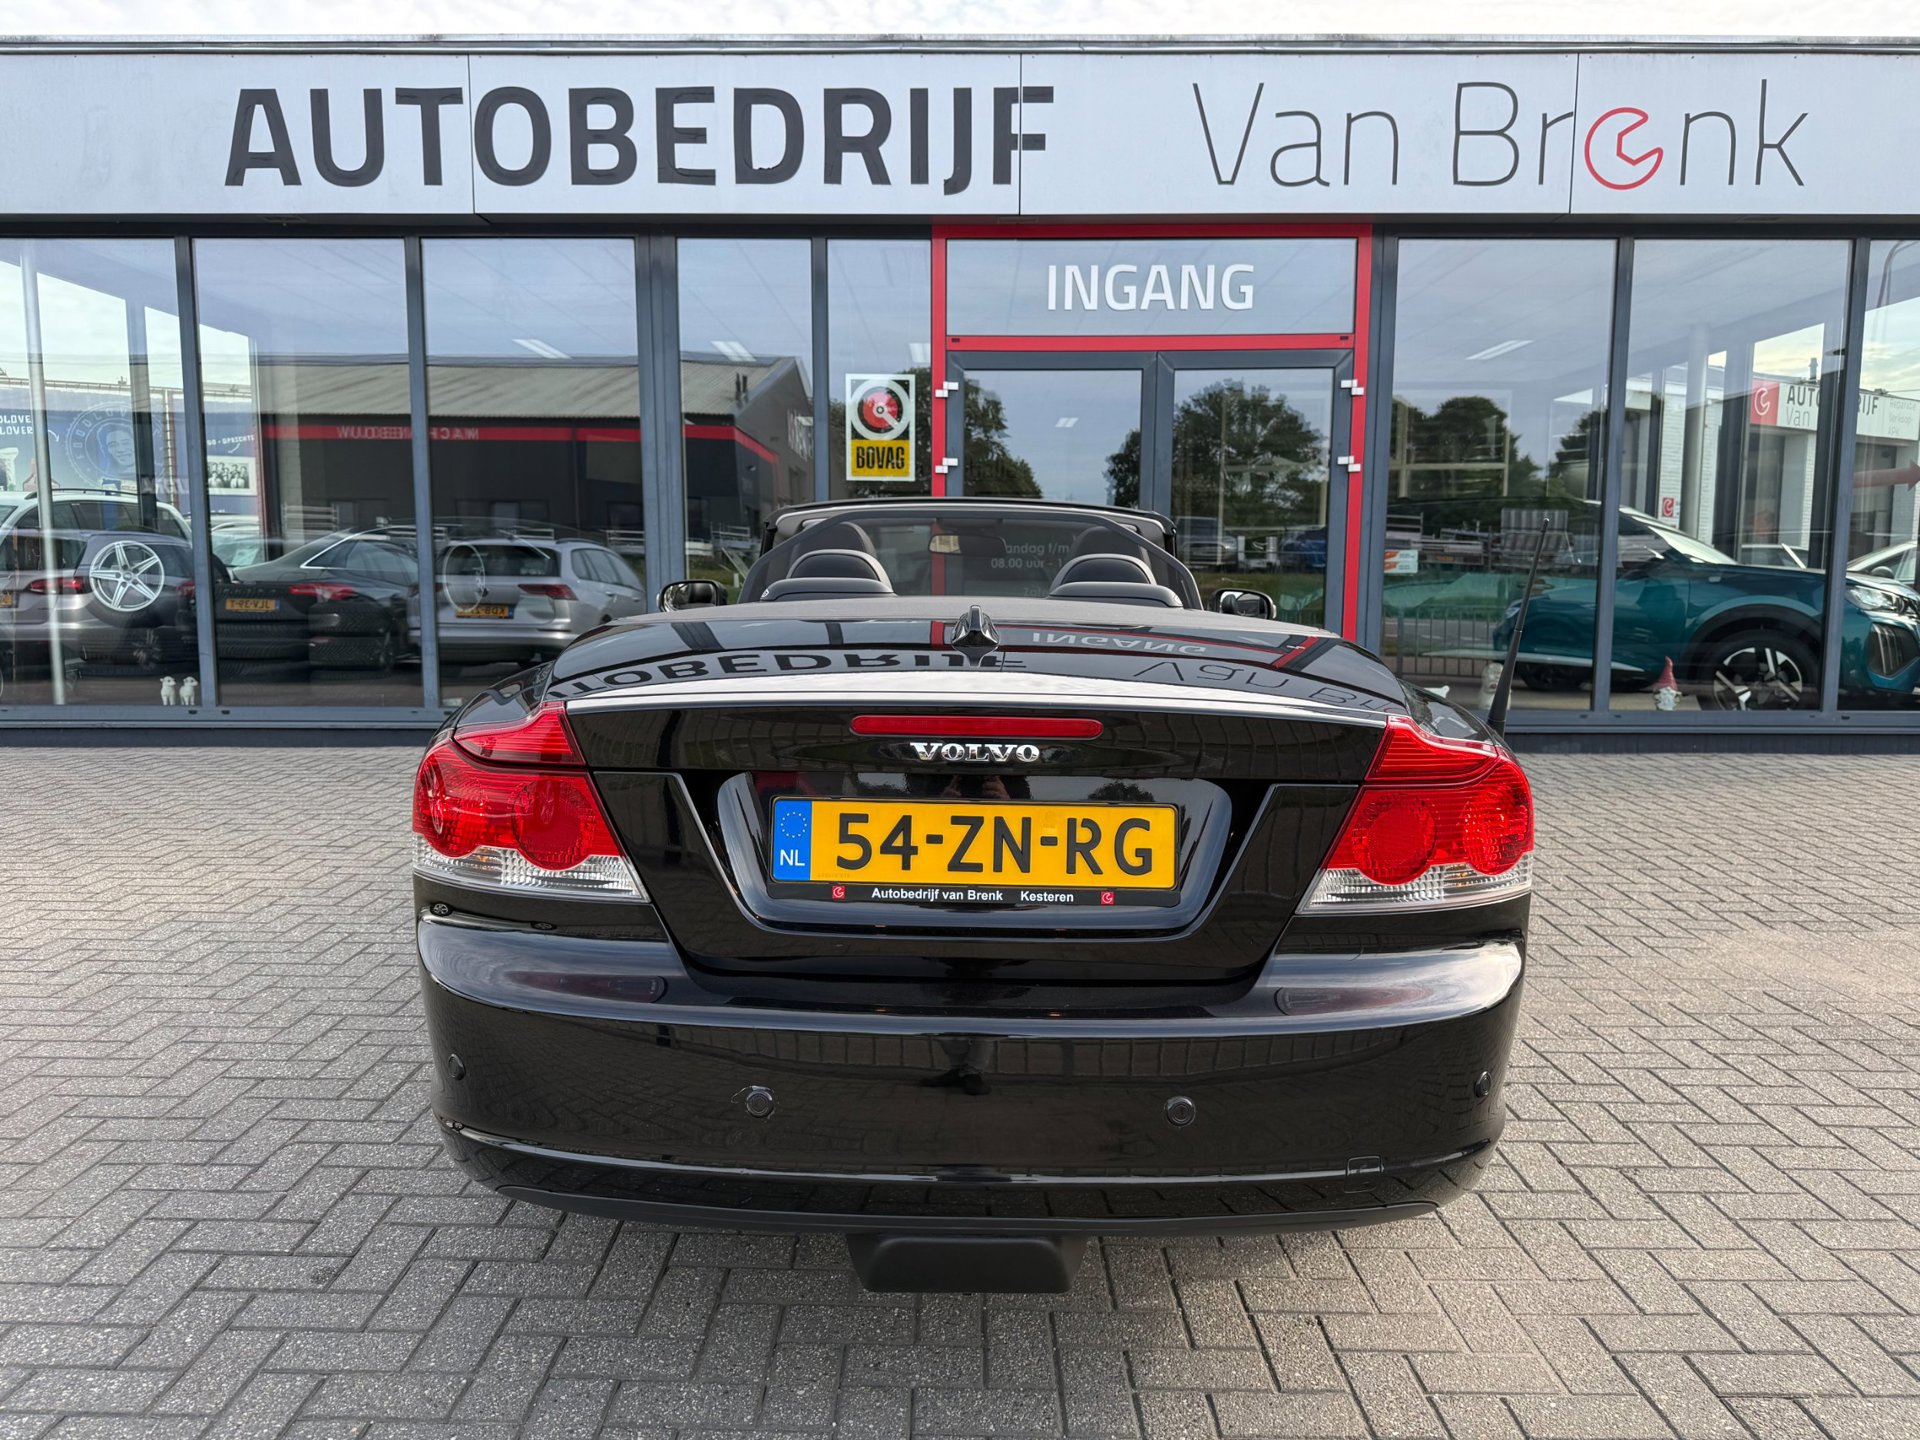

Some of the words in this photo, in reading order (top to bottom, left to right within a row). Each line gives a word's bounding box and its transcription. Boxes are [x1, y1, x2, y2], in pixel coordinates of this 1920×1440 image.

[225, 85, 1054, 195] AUTOBEDRIJF
[1192, 82, 1400, 187] Van
[1047, 263, 1255, 311] INGANG
[1786, 406, 1810, 427] Van
[856, 446, 905, 470] BOVAG
[1006, 543, 1045, 555] andag
[990, 557, 1022, 568] 08.00
[910, 742, 1040, 763] VOLVO
[779, 849, 805, 867] NL
[836, 813, 1153, 876] 54-ZN-RG
[871, 887, 939, 902] Autobedrijf
[942, 890, 964, 901] van
[968, 889, 1003, 902] Brenk
[1020, 890, 1074, 903] Kesteren
